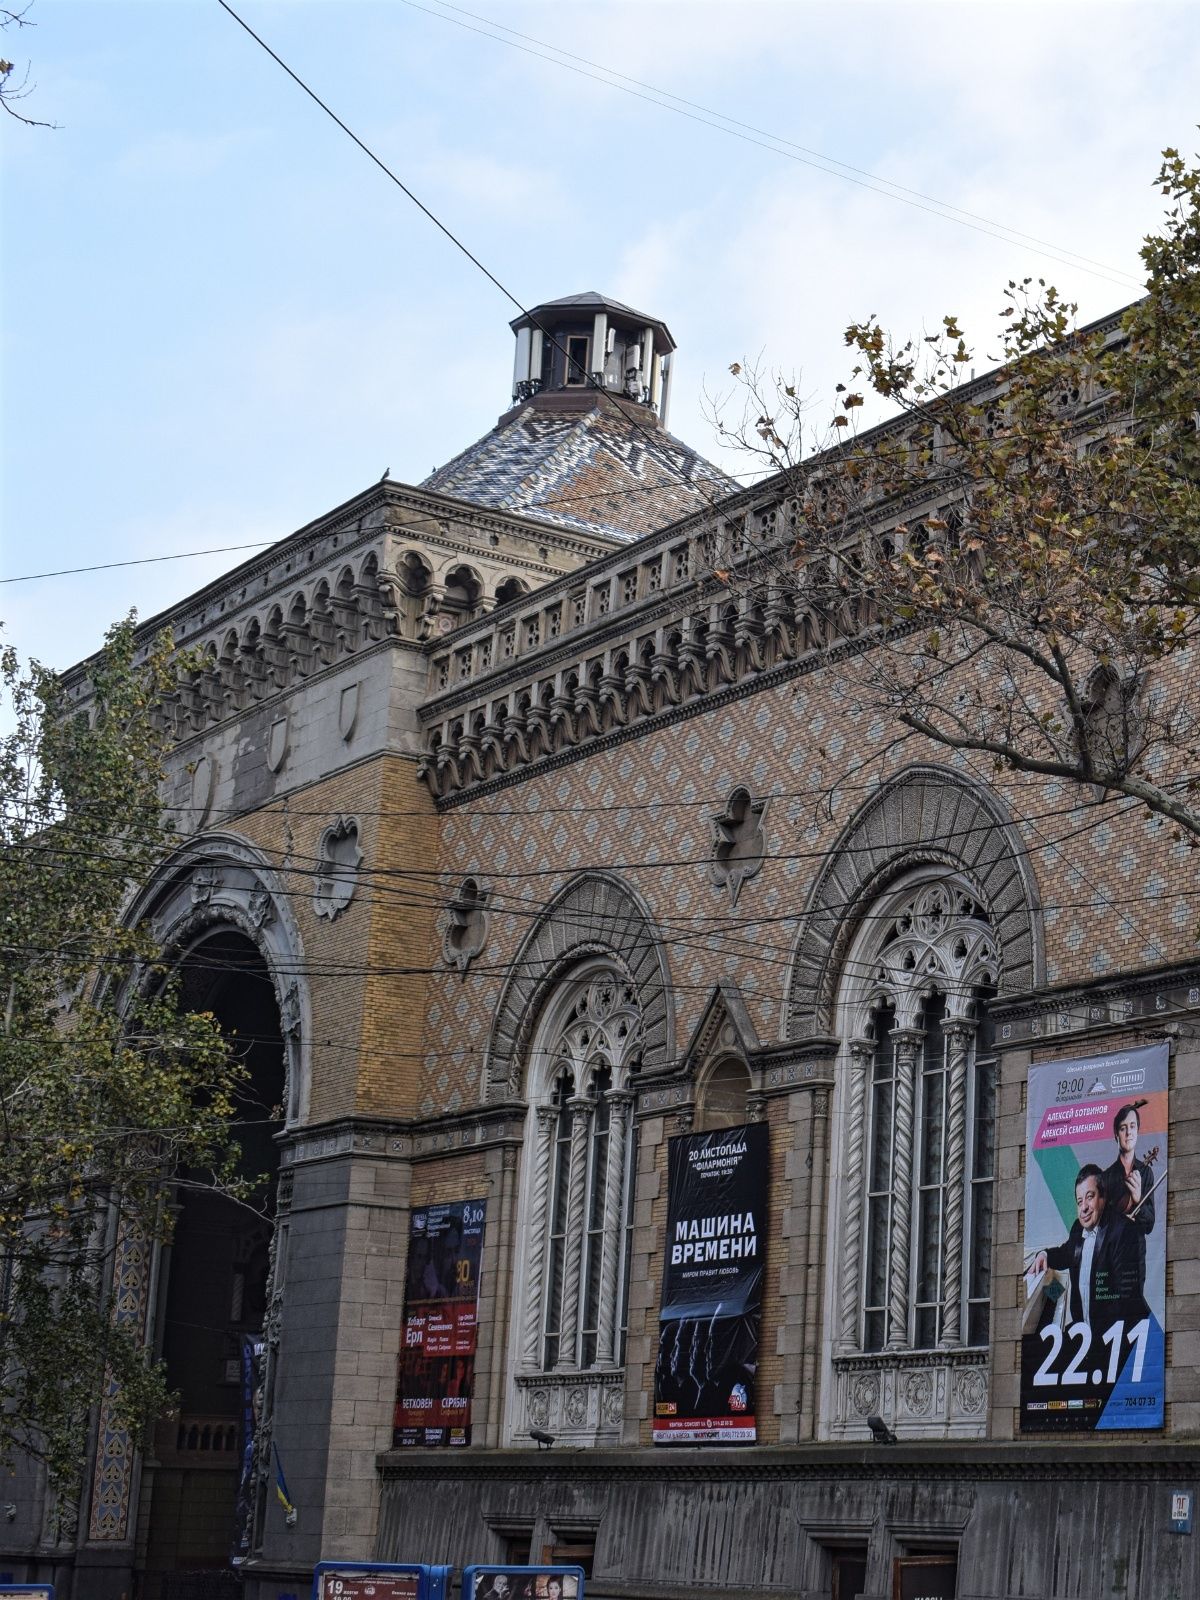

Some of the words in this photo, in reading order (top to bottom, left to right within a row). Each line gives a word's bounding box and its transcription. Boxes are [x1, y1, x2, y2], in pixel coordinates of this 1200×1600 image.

[1057, 1078, 1084, 1095] 19:00
[1047, 1108, 1074, 1121] АЛЕКСЕЙ
[1075, 1105, 1108, 1118] БОТВИНОВ
[1041, 1125, 1068, 1139] АЛЕКСЕЙ
[1068, 1121, 1105, 1135] СЕМЕНЕНКО
[689, 1150, 699, 1161] 20
[700, 1142, 748, 1159] ЛИСТОПАДА
[675, 1212, 755, 1242] МАШИНА
[671, 1235, 757, 1265] ВРЕМЕНИ
[682, 1269, 699, 1279] МИРОМ
[699, 1268, 718, 1277] ПРАВИТ
[718, 1266, 740, 1275] ЛЮБОВЬ
[1033, 1318, 1151, 1387] 22.11
[402, 1398, 433, 1409] БЕТХОВЕН
[1125, 1397, 1137, 1406] 704
[1138, 1397, 1147, 1406] 07
[1147, 1397, 1156, 1405] 33
[327, 1580, 344, 1594] 19
